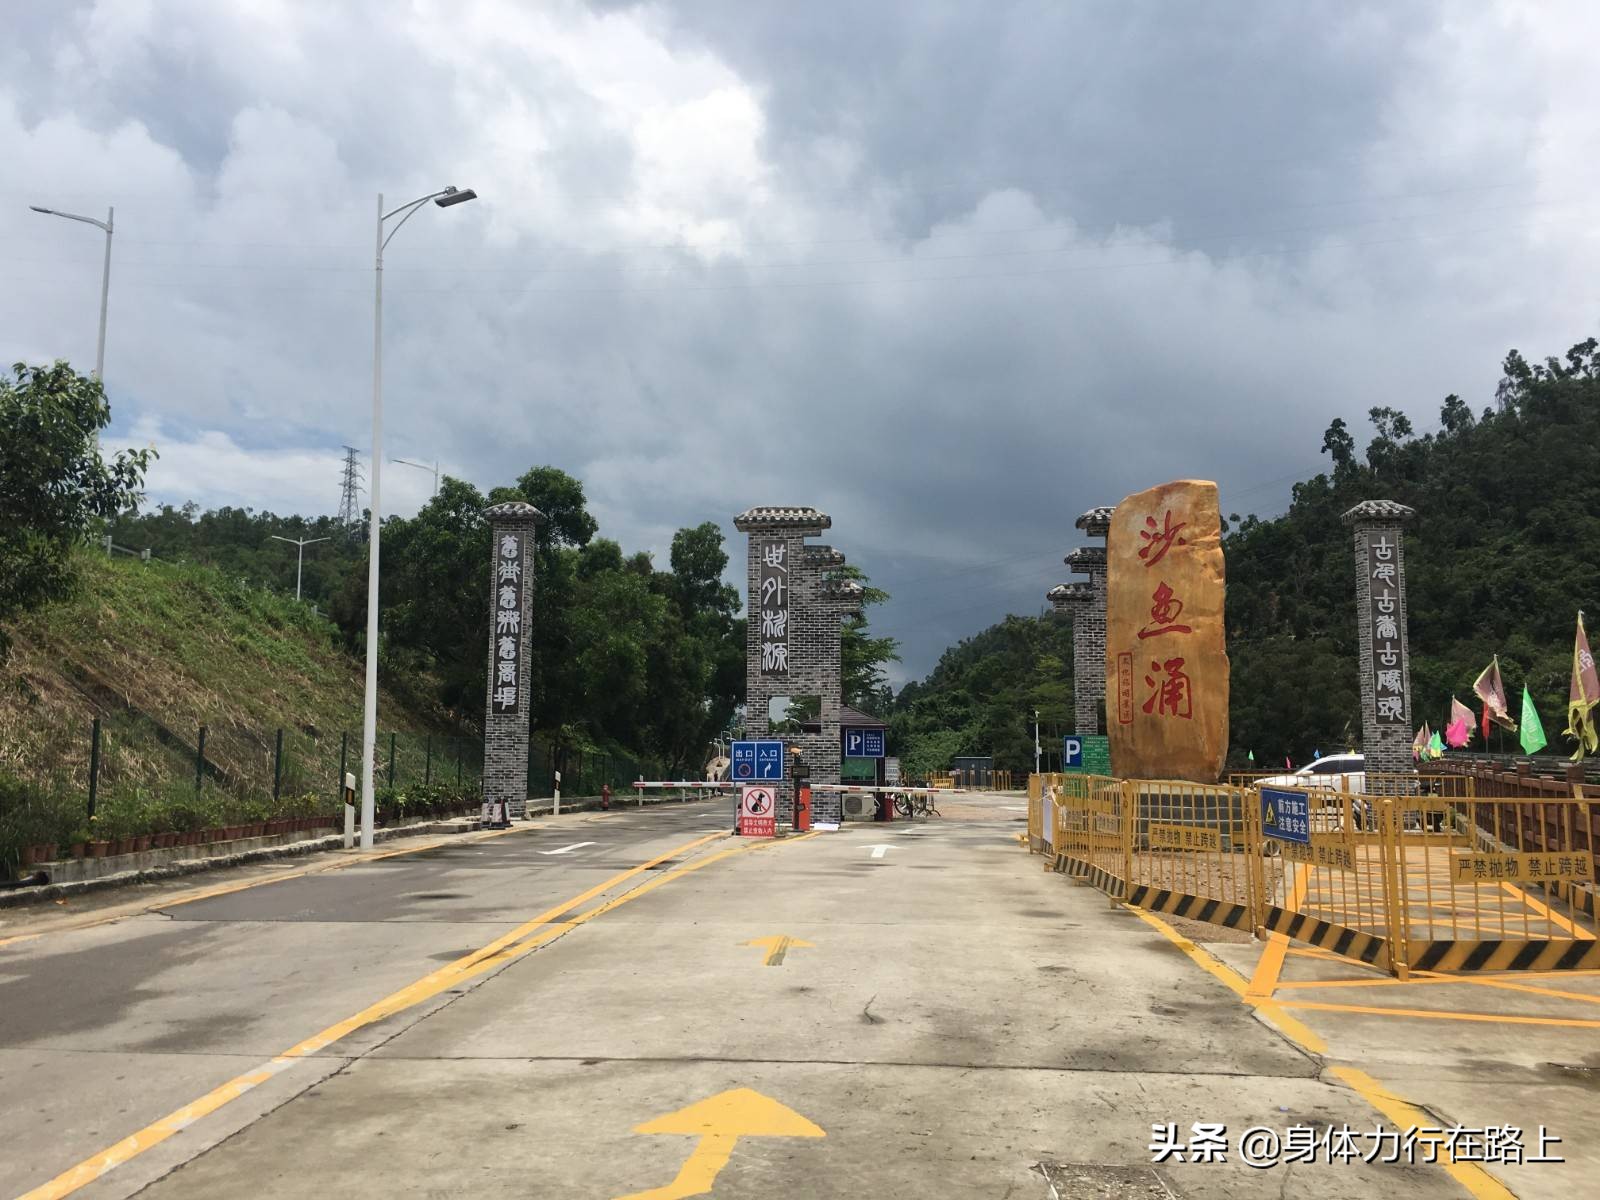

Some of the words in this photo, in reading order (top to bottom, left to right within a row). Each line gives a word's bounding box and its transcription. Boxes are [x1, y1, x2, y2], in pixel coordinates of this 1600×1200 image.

[762, 544, 787, 671] 世外桃源
[760, 749, 777, 757] 入口
[850, 735, 861, 750] P
[1066, 740, 1080, 763] P
[1278, 799, 1305, 816] 前方施工
[1279, 816, 1306, 834] 注意安全
[1152, 827, 1180, 845] 严禁抛物
[1185, 831, 1217, 849] 禁止跨越
[1318, 845, 1352, 869] 禁止跨越
[1458, 858, 1519, 878] 严禁抛物
[1528, 856, 1587, 877] 禁止跨越
